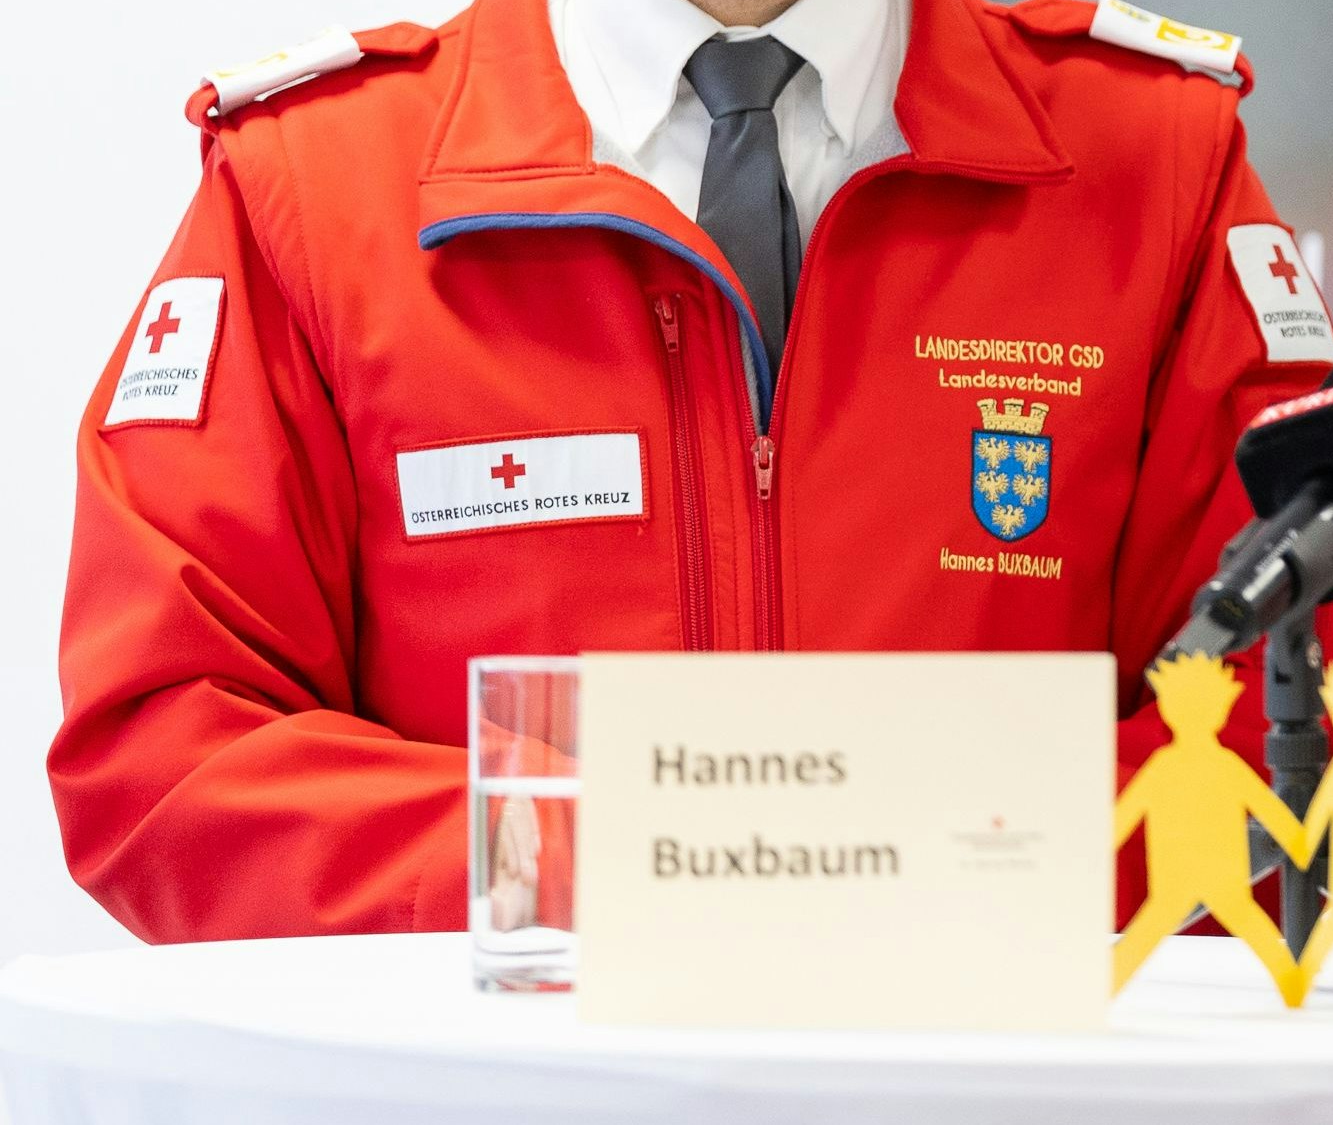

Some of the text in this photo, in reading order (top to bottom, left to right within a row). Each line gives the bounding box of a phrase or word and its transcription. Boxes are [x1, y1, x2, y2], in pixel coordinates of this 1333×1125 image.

[915, 335, 1105, 370] LANDESDIREKTOR GSD
[144, 384, 179, 397] KREUZ
[938, 367, 1083, 397] Landesverband
[535, 494, 579, 510] ROTES
[584, 491, 631, 505] KREUZ
[939, 547, 1063, 580] Hannes BUXBAUM
[651, 744, 849, 787] Hannes
[651, 835, 901, 880] Buxbaum
